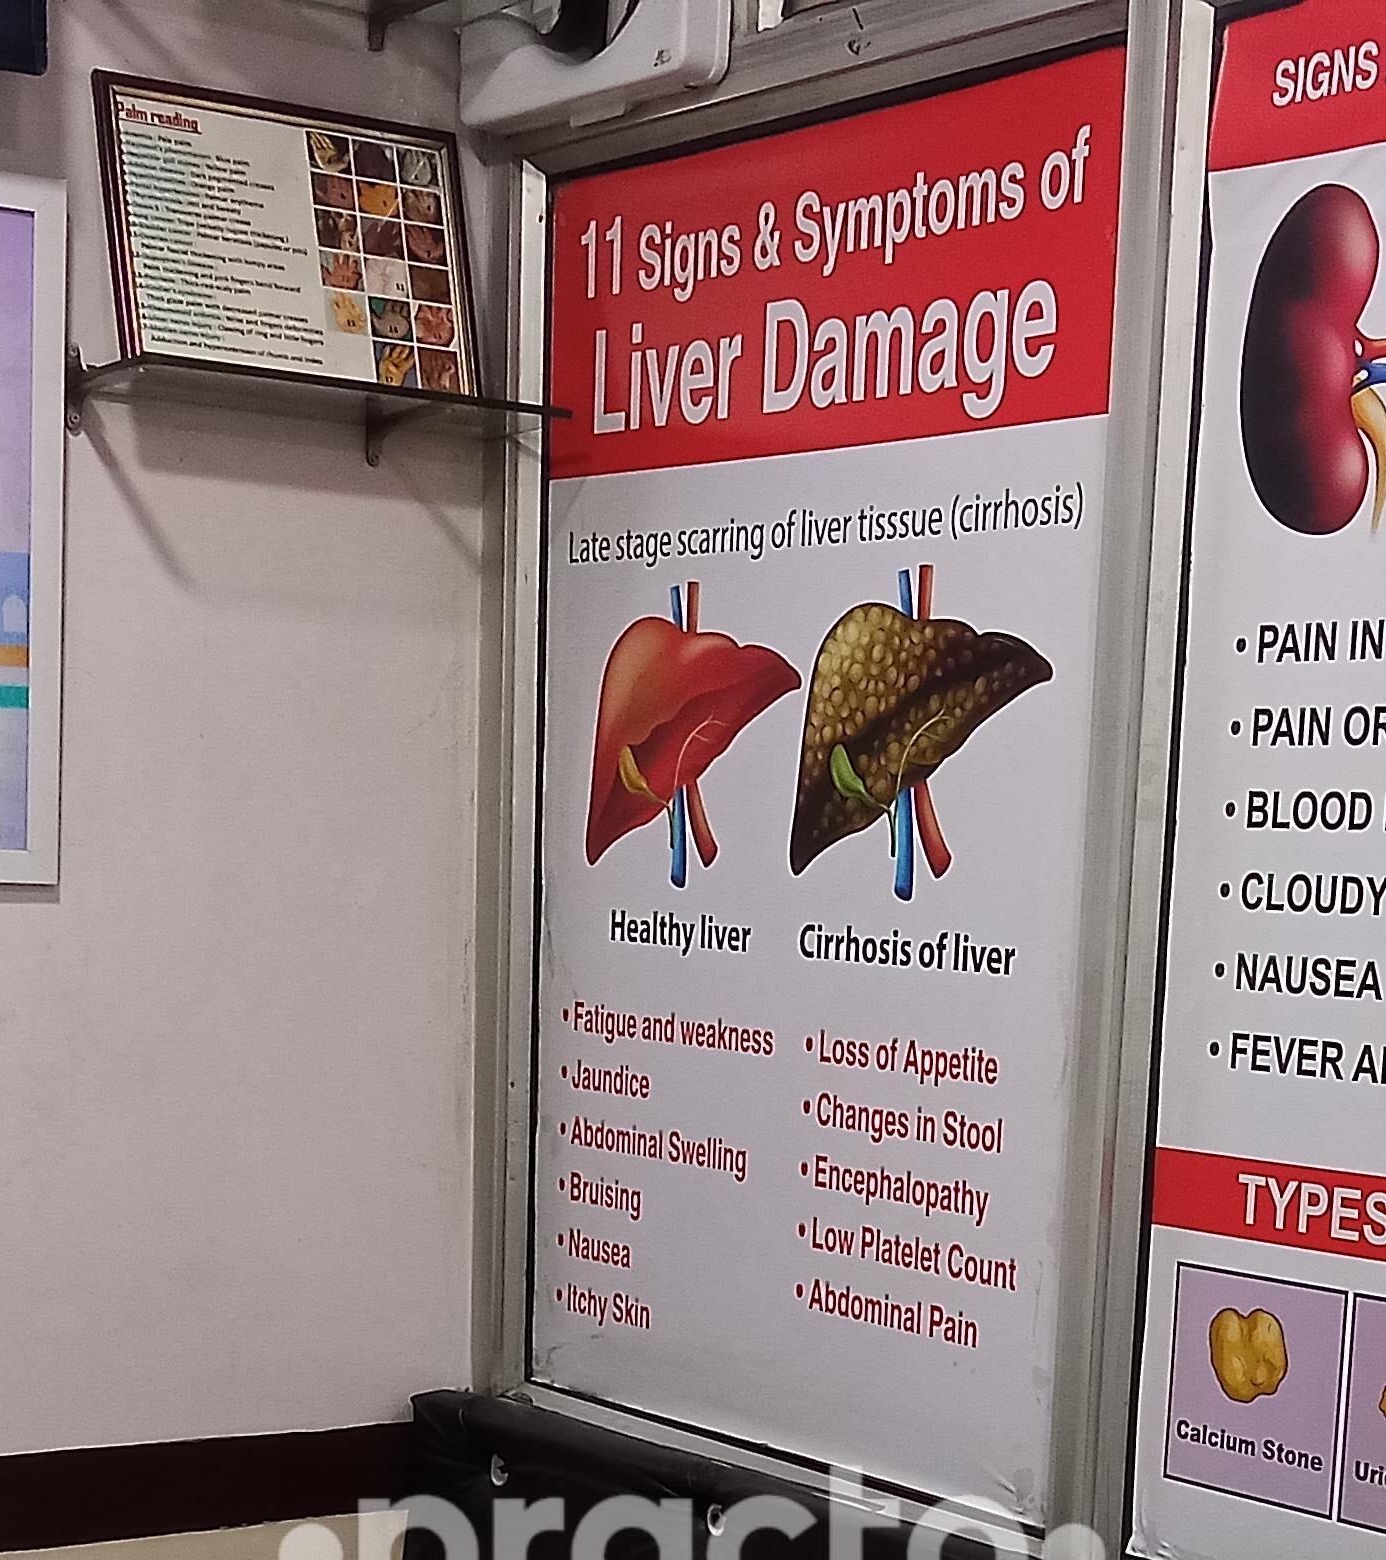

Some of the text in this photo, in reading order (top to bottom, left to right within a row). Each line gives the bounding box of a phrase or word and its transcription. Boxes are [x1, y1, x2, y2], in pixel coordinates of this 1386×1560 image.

[1272, 41, 1379, 107] SIGNS
[149, 109, 200, 132] reading
[581, 124, 1091, 302] 11 Signs & Symptoms of
[593, 280, 1057, 435] Liver Damage
[569, 481, 1083, 568] Late stage scarring of liver tisssue (cirrhosis)
[1257, 621, 1338, 664] PAIN
[1349, 619, 1385, 661] IN
[1251, 706, 1332, 747] PAIN
[1246, 790, 1372, 831] BLOOD
[610, 909, 752, 957] Healthy liver
[799, 924, 1016, 976] Cirrhosis of liver
[1235, 952, 1383, 1001] NAUSEA
[573, 1000, 774, 1056] Fatigue and weakness
[571, 1058, 650, 1099] Jaundice
[819, 1029, 998, 1087] Loss of Appetite
[1230, 1032, 1344, 1081] FEVER
[570, 1115, 747, 1183] Abdominal Swelling
[817, 1092, 1003, 1154] Changes in Stool
[570, 1171, 641, 1221] Bruising
[814, 1154, 989, 1227] Encephalopathy
[568, 1227, 631, 1269] Nausea
[812, 1216, 1017, 1292] Low Platelet Count
[567, 1282, 650, 1330] Itchy Skin
[808, 1278, 977, 1349] Abdominal Pain
[1176, 1419, 1323, 1472] Calcium Stone
